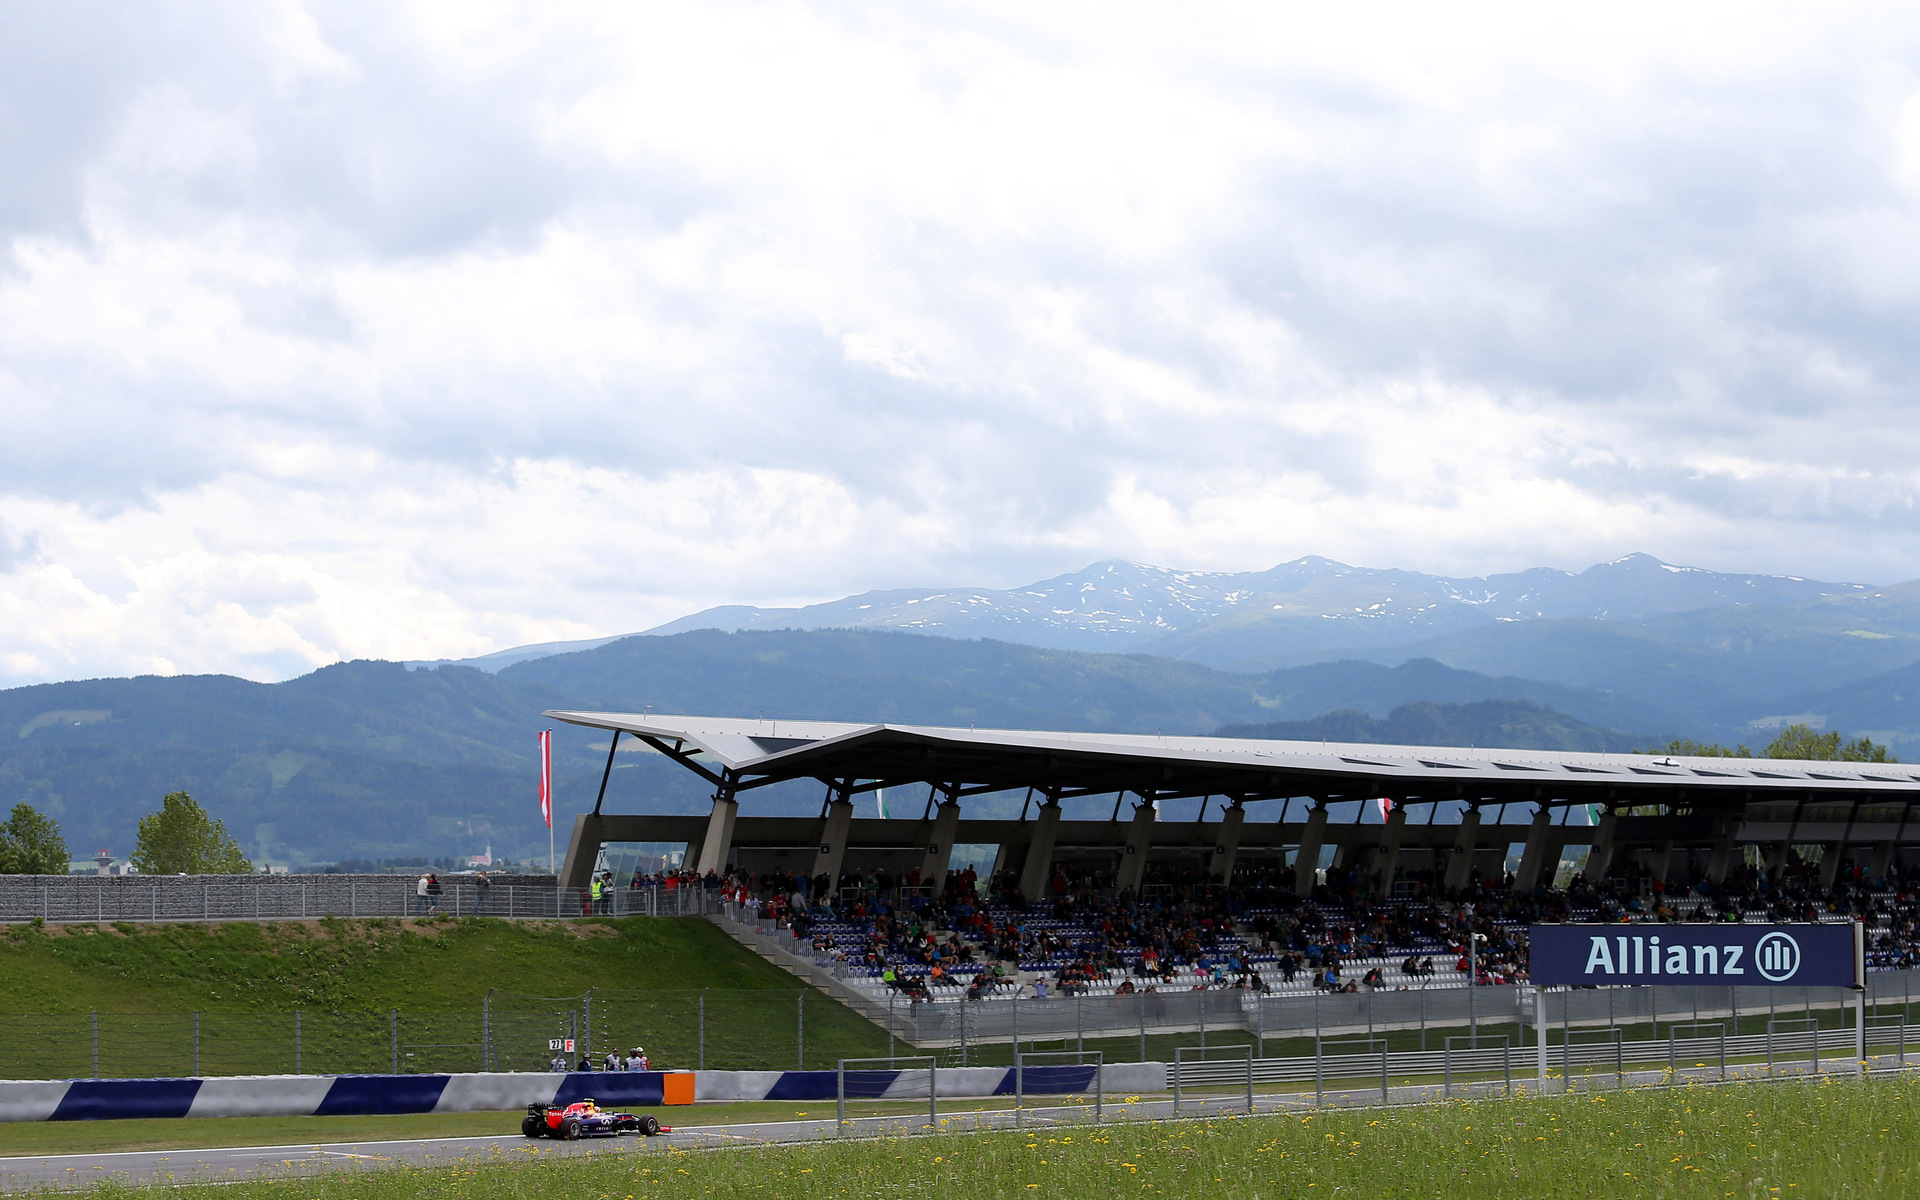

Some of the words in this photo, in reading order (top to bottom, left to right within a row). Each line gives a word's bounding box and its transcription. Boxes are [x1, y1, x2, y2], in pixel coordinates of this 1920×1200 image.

[1584, 936, 1744, 974] Allianz
[552, 1040, 560, 1048] 27
[566, 1040, 573, 1051] F
